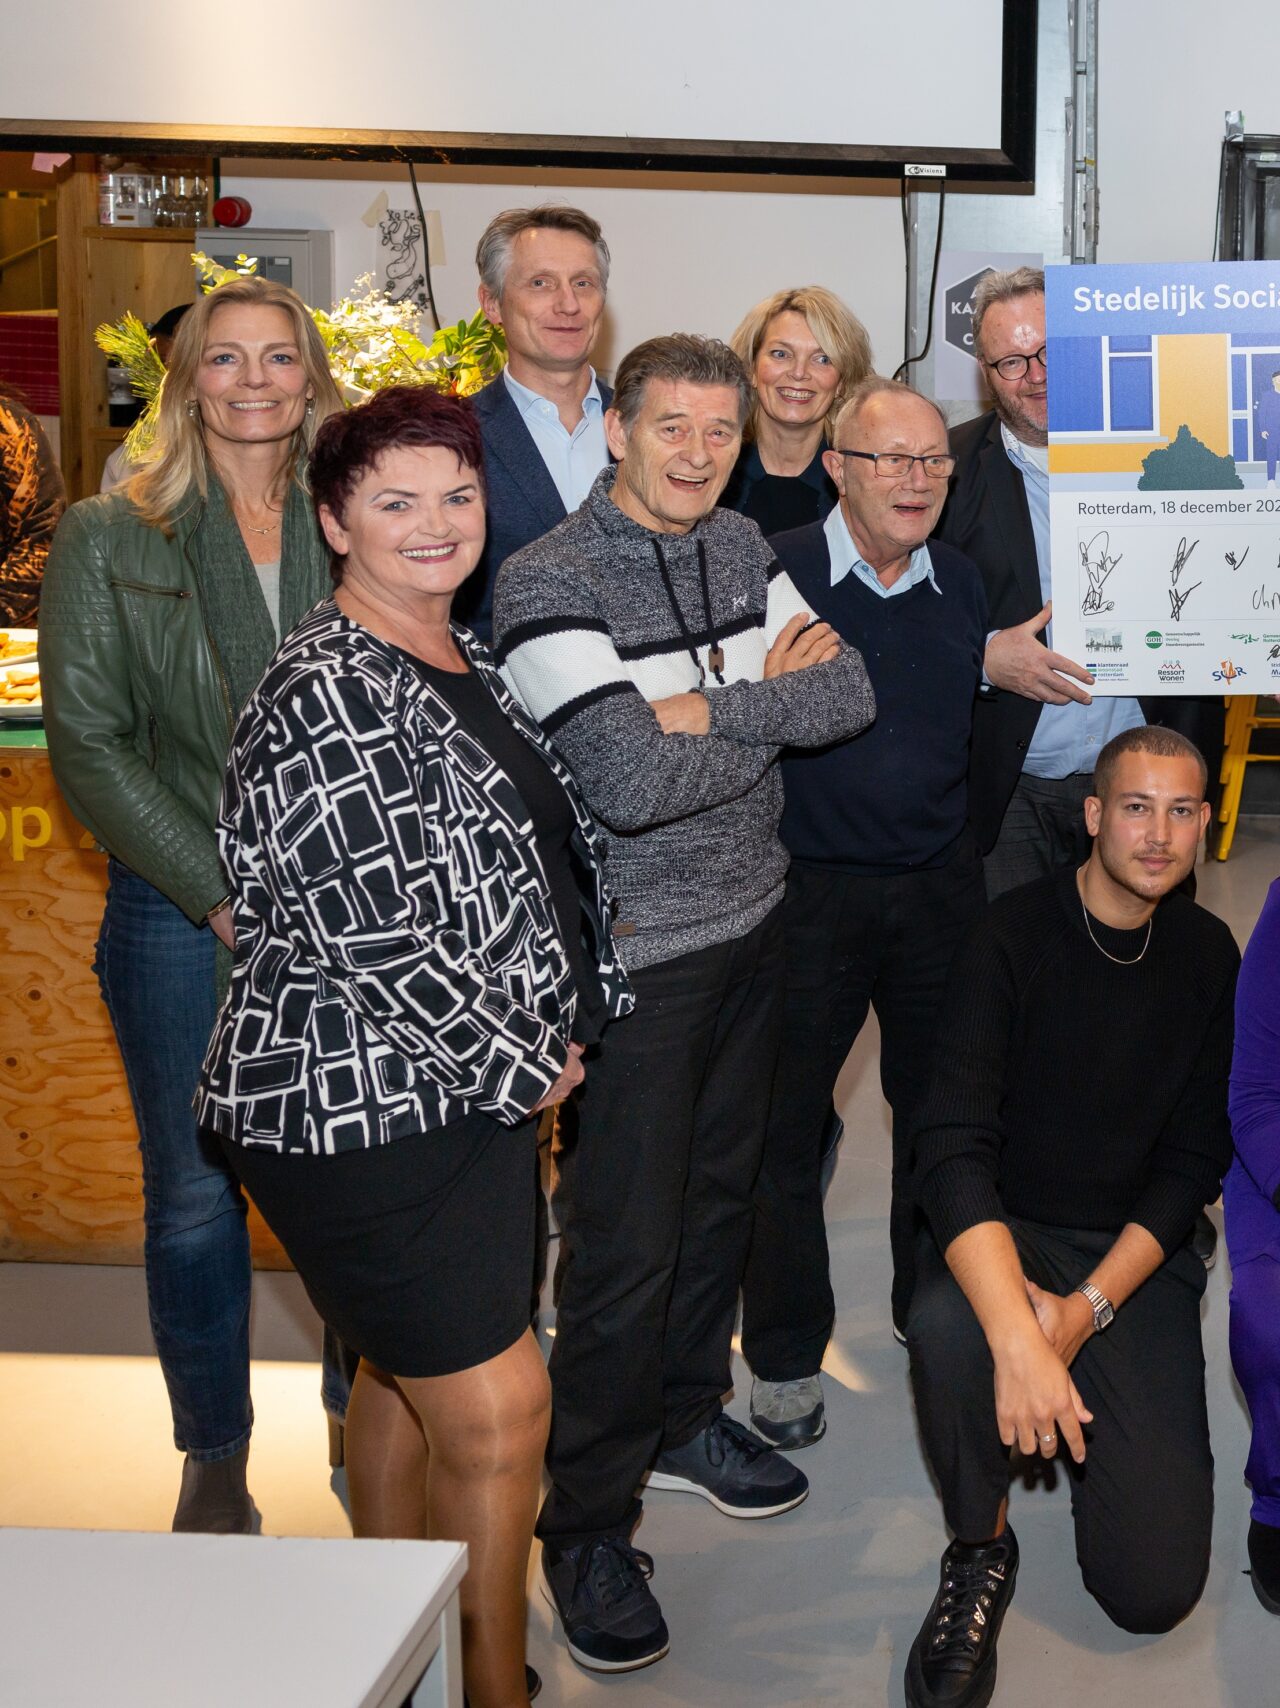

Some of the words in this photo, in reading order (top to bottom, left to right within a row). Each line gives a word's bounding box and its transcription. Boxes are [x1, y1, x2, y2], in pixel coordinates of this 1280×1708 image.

[1074, 284, 1206, 316] Stedelijk
[1078, 501, 1156, 515] Rotterdam,
[1161, 501, 1176, 514] 18
[1180, 500, 1252, 513] december
[0, 806, 52, 861] p
